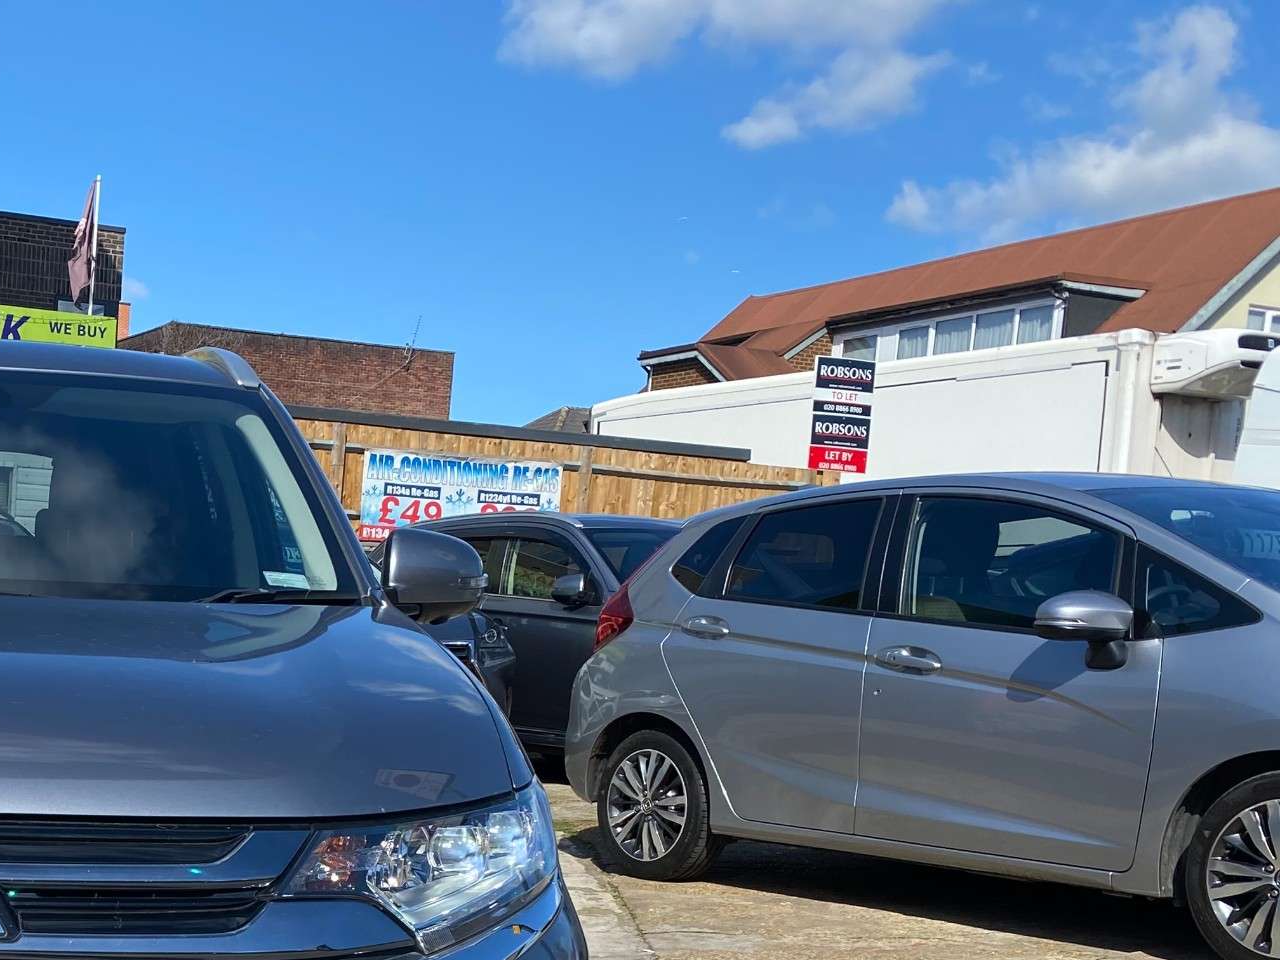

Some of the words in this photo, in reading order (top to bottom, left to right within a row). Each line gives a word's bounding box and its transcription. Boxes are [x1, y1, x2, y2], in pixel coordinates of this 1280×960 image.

[49, 321, 72, 335] WE
[77, 324, 107, 339] BUY
[820, 364, 872, 381] ROBSONS
[832, 391, 843, 400] TO
[845, 392, 858, 402] LET
[815, 421, 867, 438] ROBSONS
[824, 450, 840, 461] LET
[841, 451, 853, 462] BY
[367, 453, 508, 490] AIR-CONDITIONING
[511, 465, 559, 494] RE-GAS
[411, 488, 439, 498] Re-Gas
[511, 494, 538, 505] Re-Gas
[378, 495, 442, 525] £49
